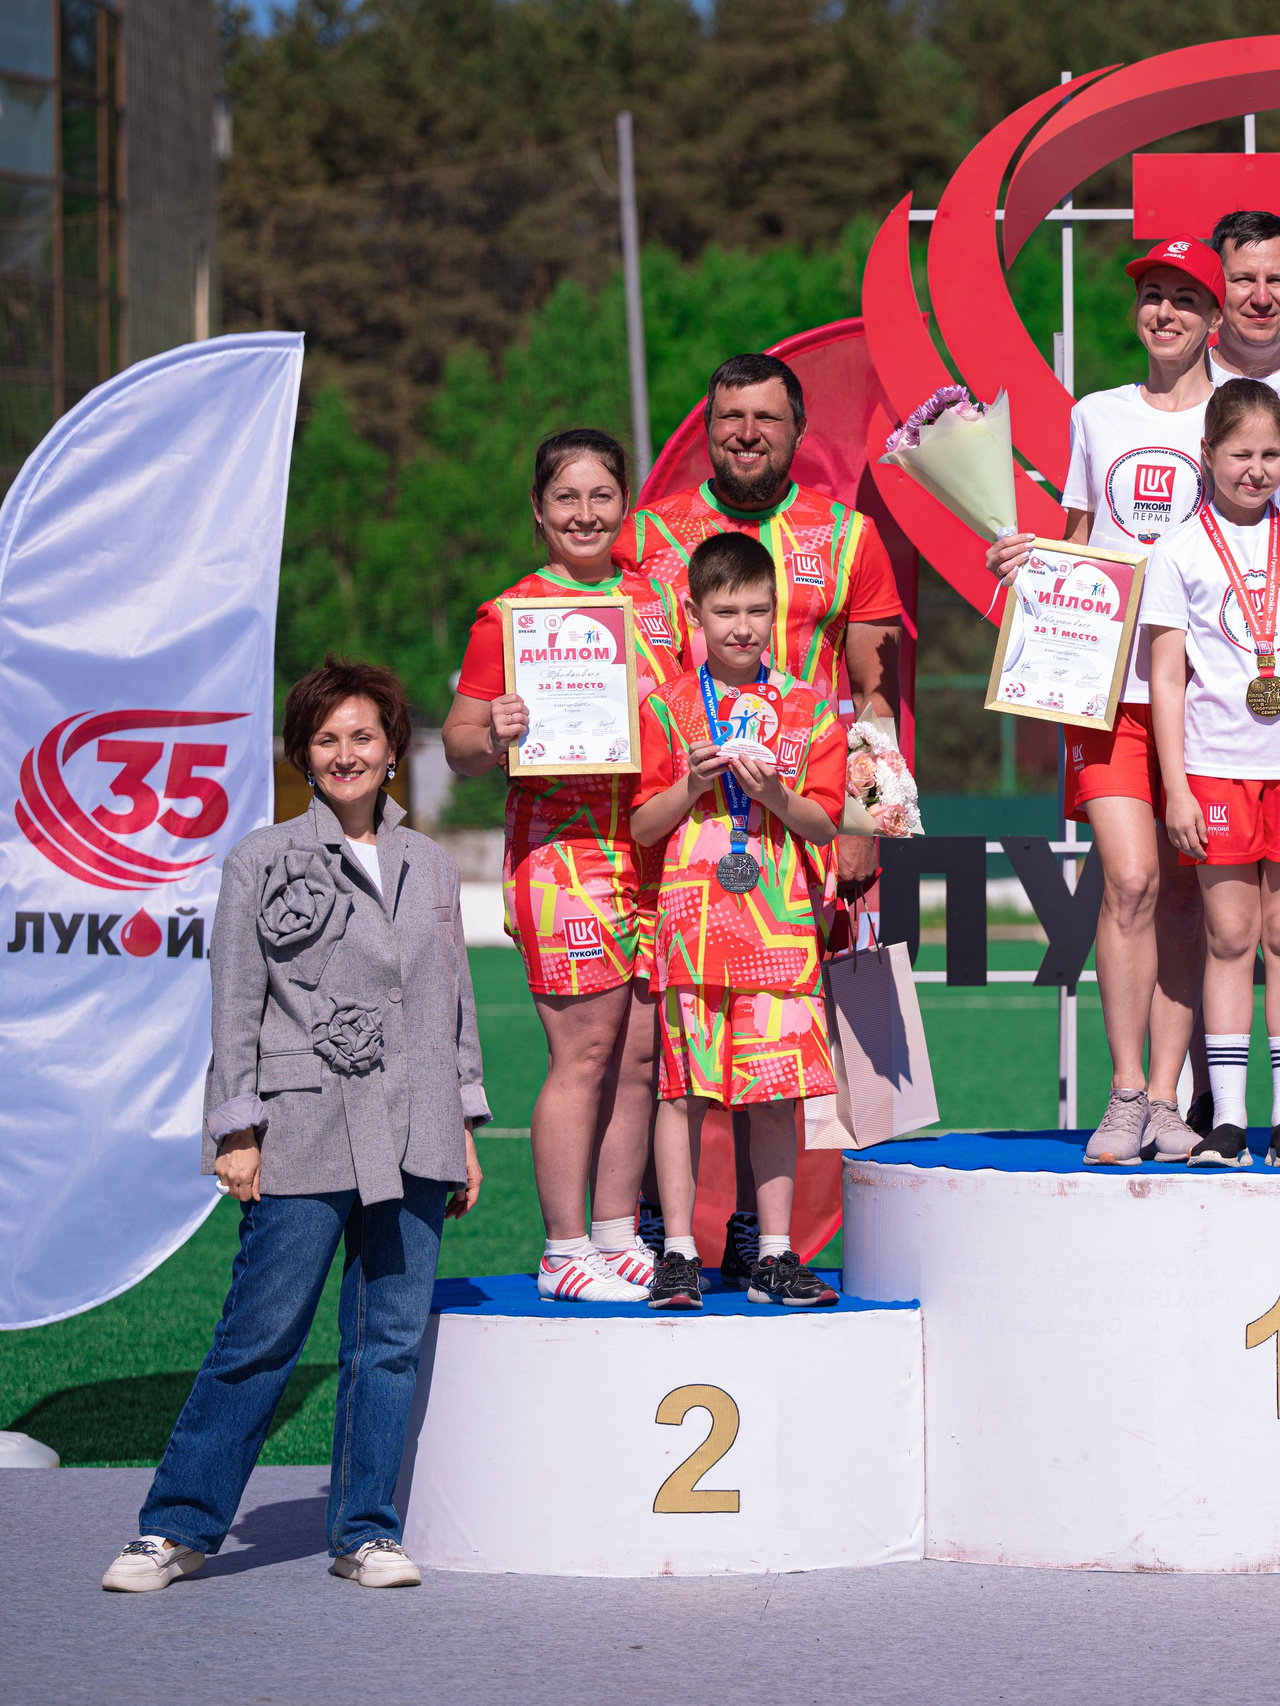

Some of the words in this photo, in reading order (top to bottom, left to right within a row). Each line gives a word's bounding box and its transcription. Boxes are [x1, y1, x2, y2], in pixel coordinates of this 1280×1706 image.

[1109, 458, 1126, 486] ПЕРВИЧНАЯ
[1125, 450, 1168, 460] ПРОФСОЮЗНАЯ
[1168, 452, 1199, 474] ОРГАНИЗАЦИЯ
[1132, 512, 1170, 522] ПЕРМЬ
[1134, 502, 1172, 512] ЛУКОЙЛ
[796, 577, 824, 586] ЛУКОЙЛ
[1034, 590, 1112, 615] ИПЛОМ
[1034, 626, 1046, 634] за
[1062, 630, 1098, 642] место
[520, 648, 610, 663] ДИПЛОМ
[90, 739, 229, 840] 35
[726, 772, 738, 808] Корпоратив
[7, 906, 210, 960] ЛУКОЙ
[570, 949, 602, 958] ЛУКОЙЛ
[653, 1384, 741, 1514] 2
